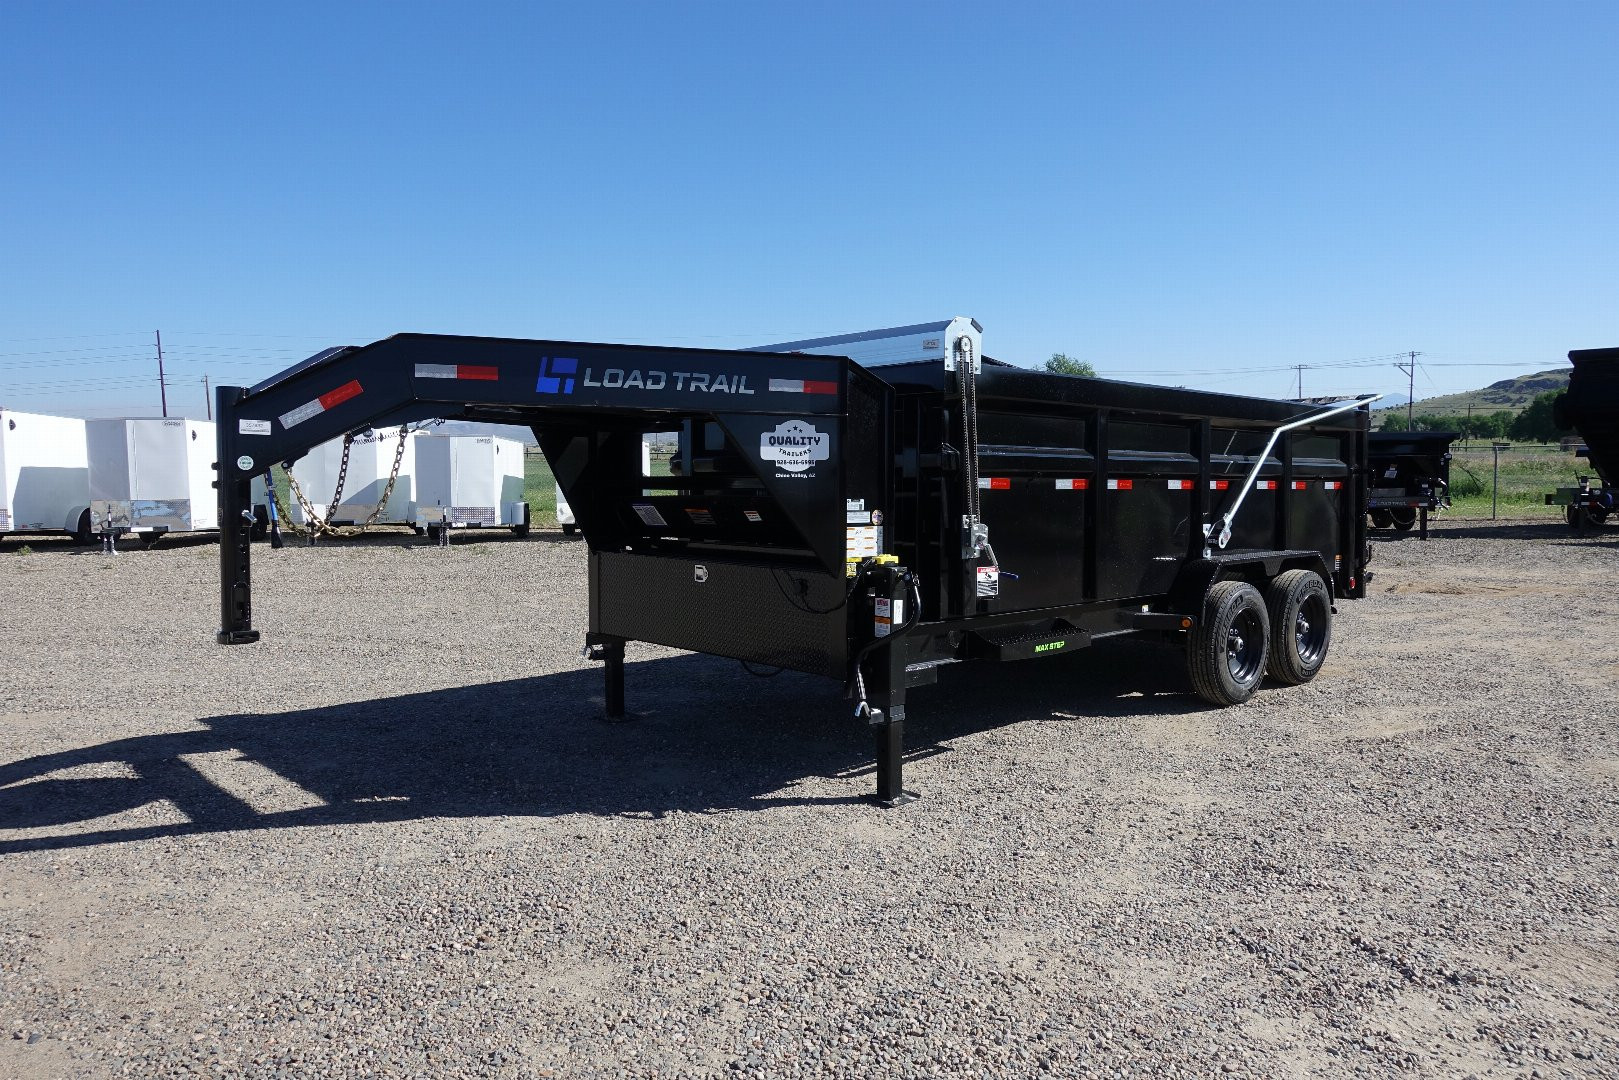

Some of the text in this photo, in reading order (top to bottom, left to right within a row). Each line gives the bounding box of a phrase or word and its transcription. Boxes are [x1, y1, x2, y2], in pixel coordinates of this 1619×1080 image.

[584, 367, 755, 395] LOAD TRAIL
[768, 435, 821, 447] QUALITY
[778, 447, 812, 457] TRAILERS
[1034, 640, 1065, 653] MAX STEP
